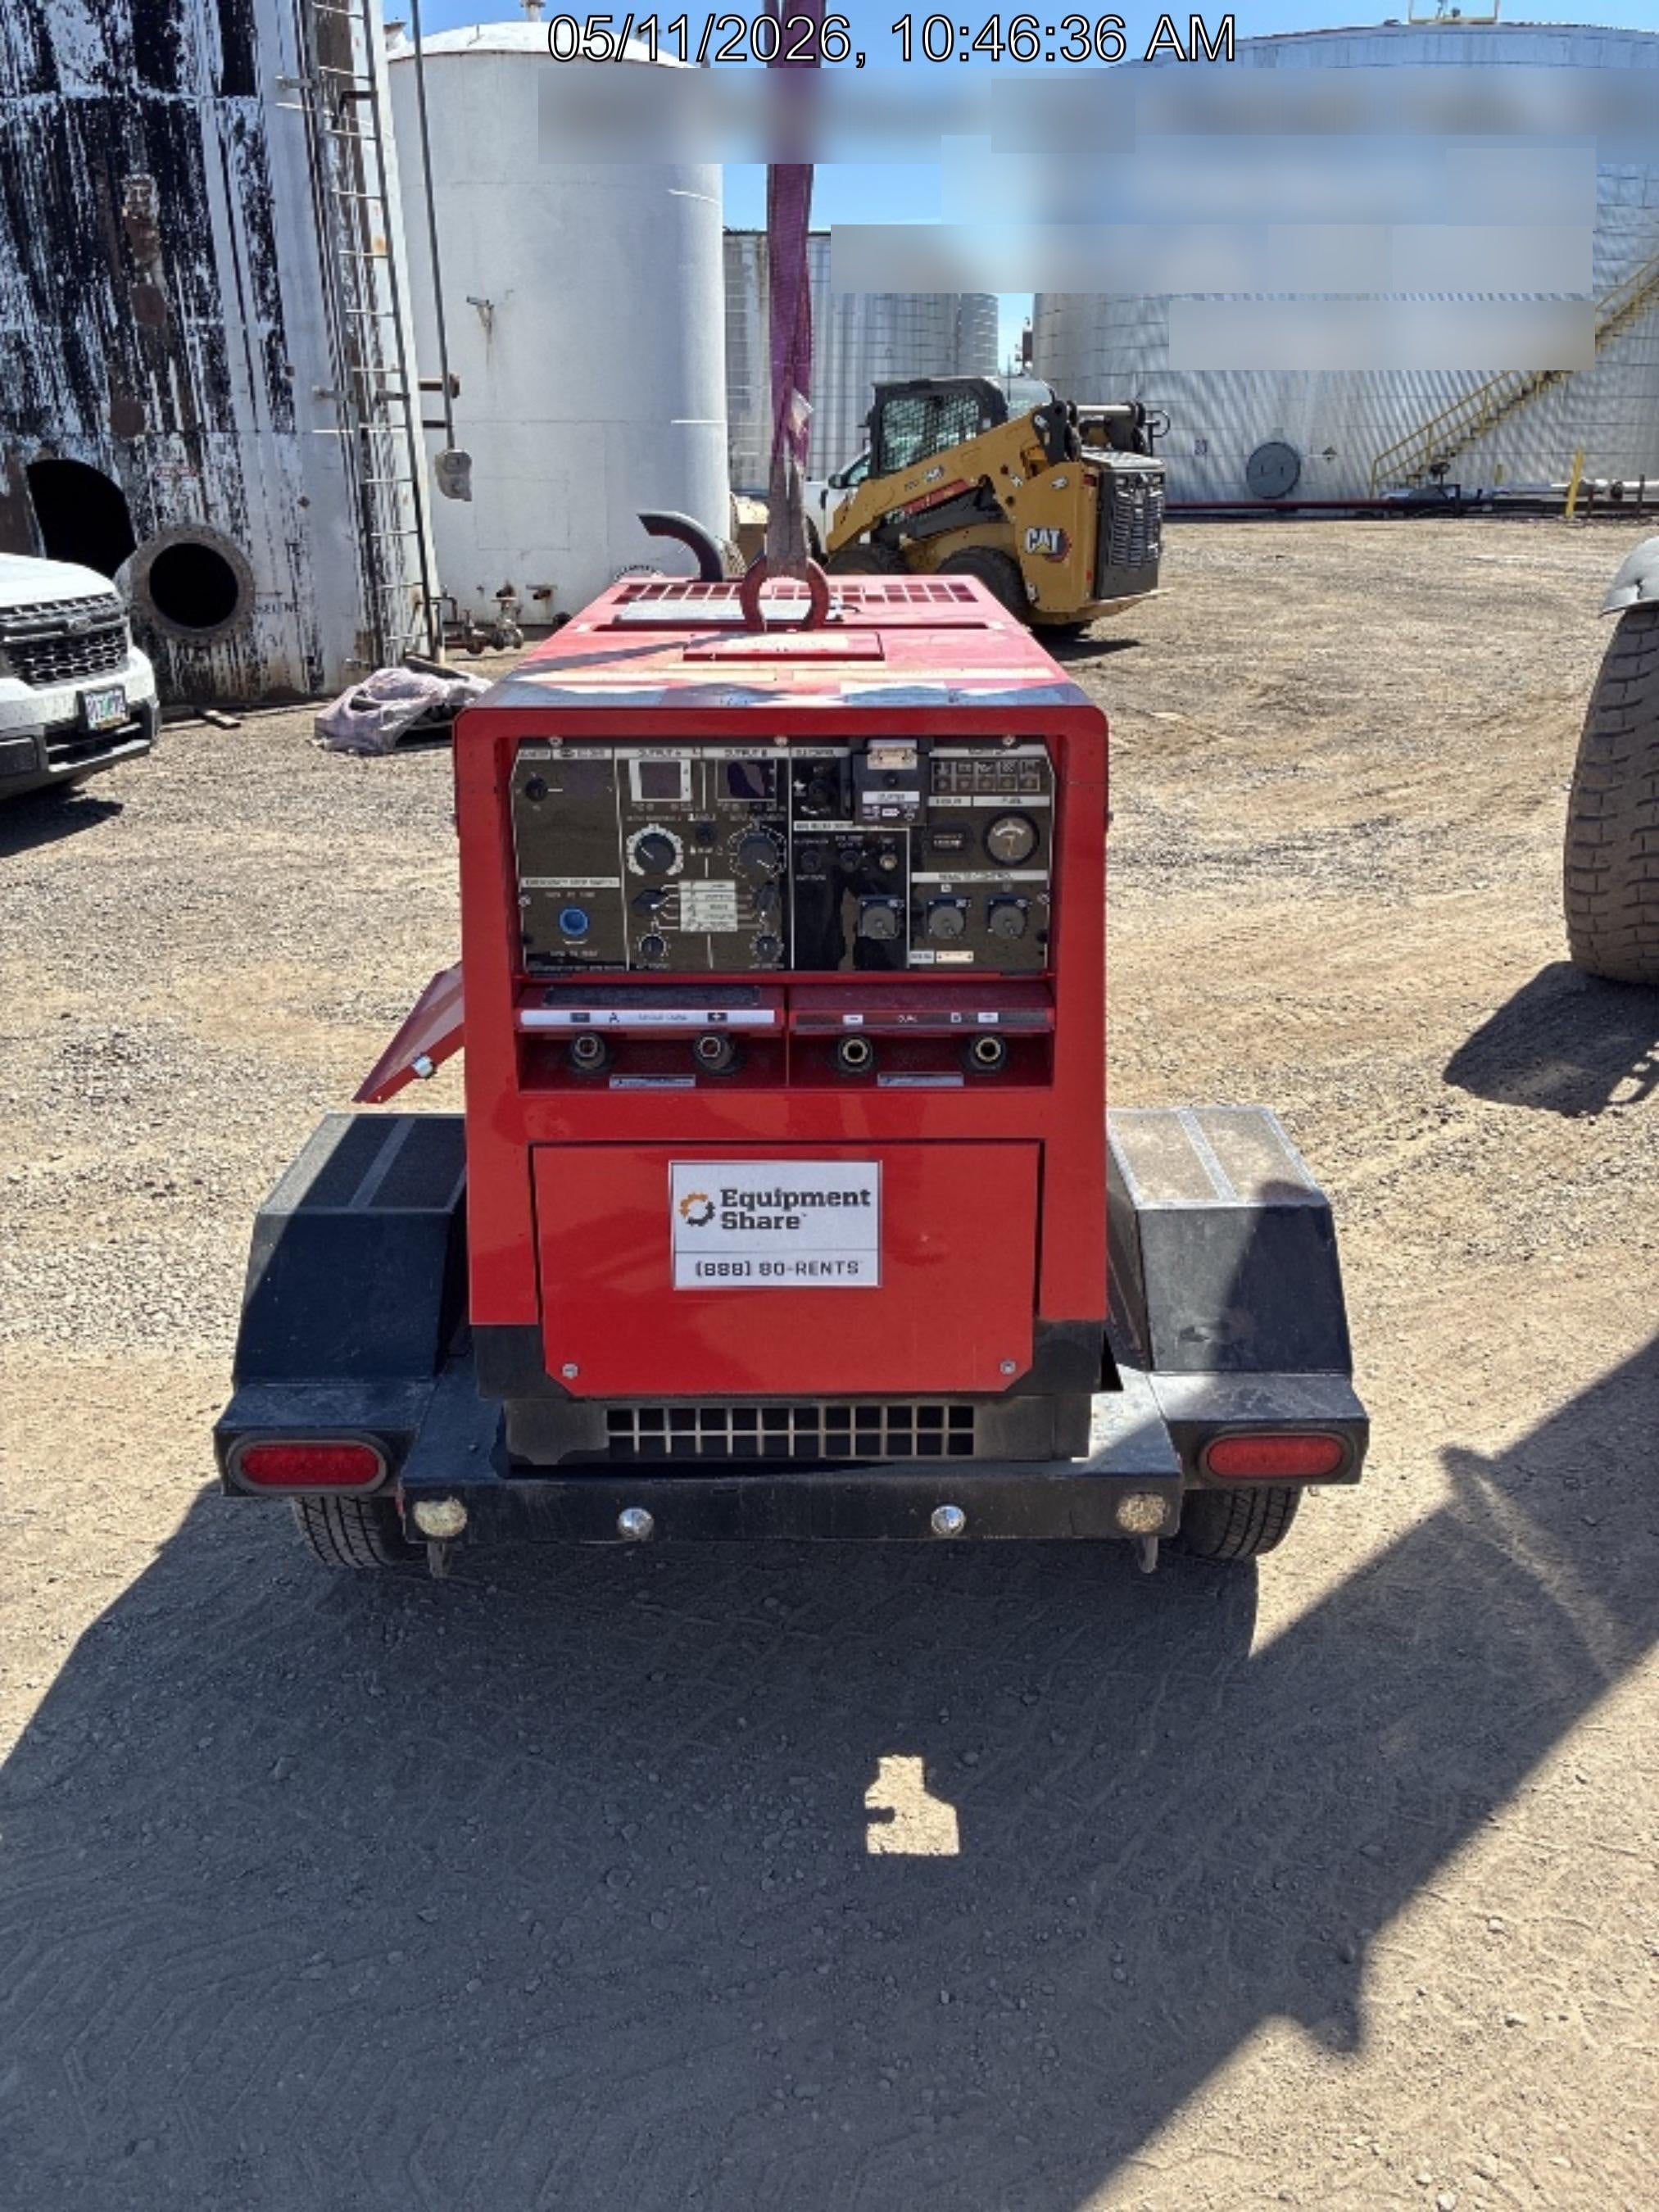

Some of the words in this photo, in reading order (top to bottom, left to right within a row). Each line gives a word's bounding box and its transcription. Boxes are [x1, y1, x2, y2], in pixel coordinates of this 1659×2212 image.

[1026, 528, 1059, 554] CAT
[720, 1188, 870, 1211] Equipment
[721, 1211, 800, 1230] Share
[759, 1261, 859, 1276] 80-RENTS
